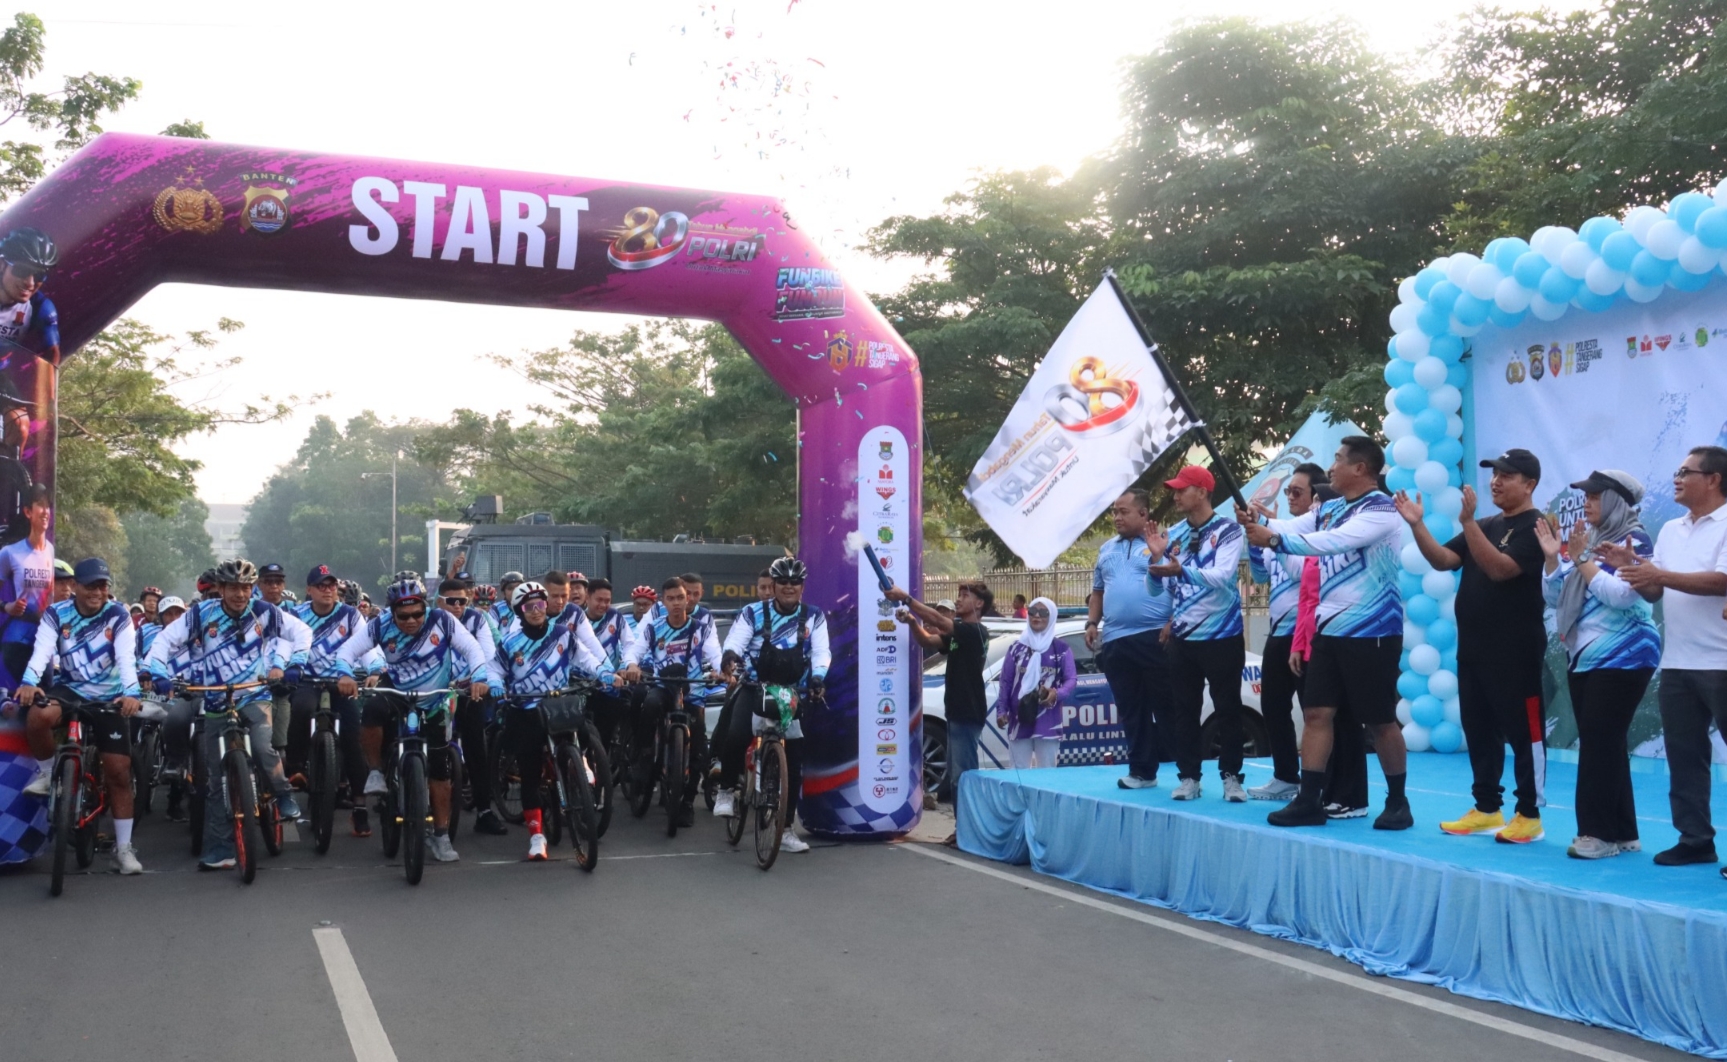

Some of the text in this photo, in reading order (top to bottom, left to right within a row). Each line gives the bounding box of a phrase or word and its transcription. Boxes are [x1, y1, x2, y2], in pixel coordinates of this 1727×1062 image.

[242, 172, 294, 185] BANTEN
[348, 175, 590, 270] START
[610, 206, 690, 265] 80
[686, 236, 758, 261] POLRI
[1575, 338, 1598, 352] POLRESTA
[1576, 348, 1603, 362] TANGERANG
[1576, 361, 1590, 374] SIGAP
[1559, 493, 1587, 513] POLR
[713, 585, 756, 597] POLI
[886, 656, 897, 664] BRI
[1062, 704, 1118, 727] POLI
[1063, 733, 1095, 741] LALU
